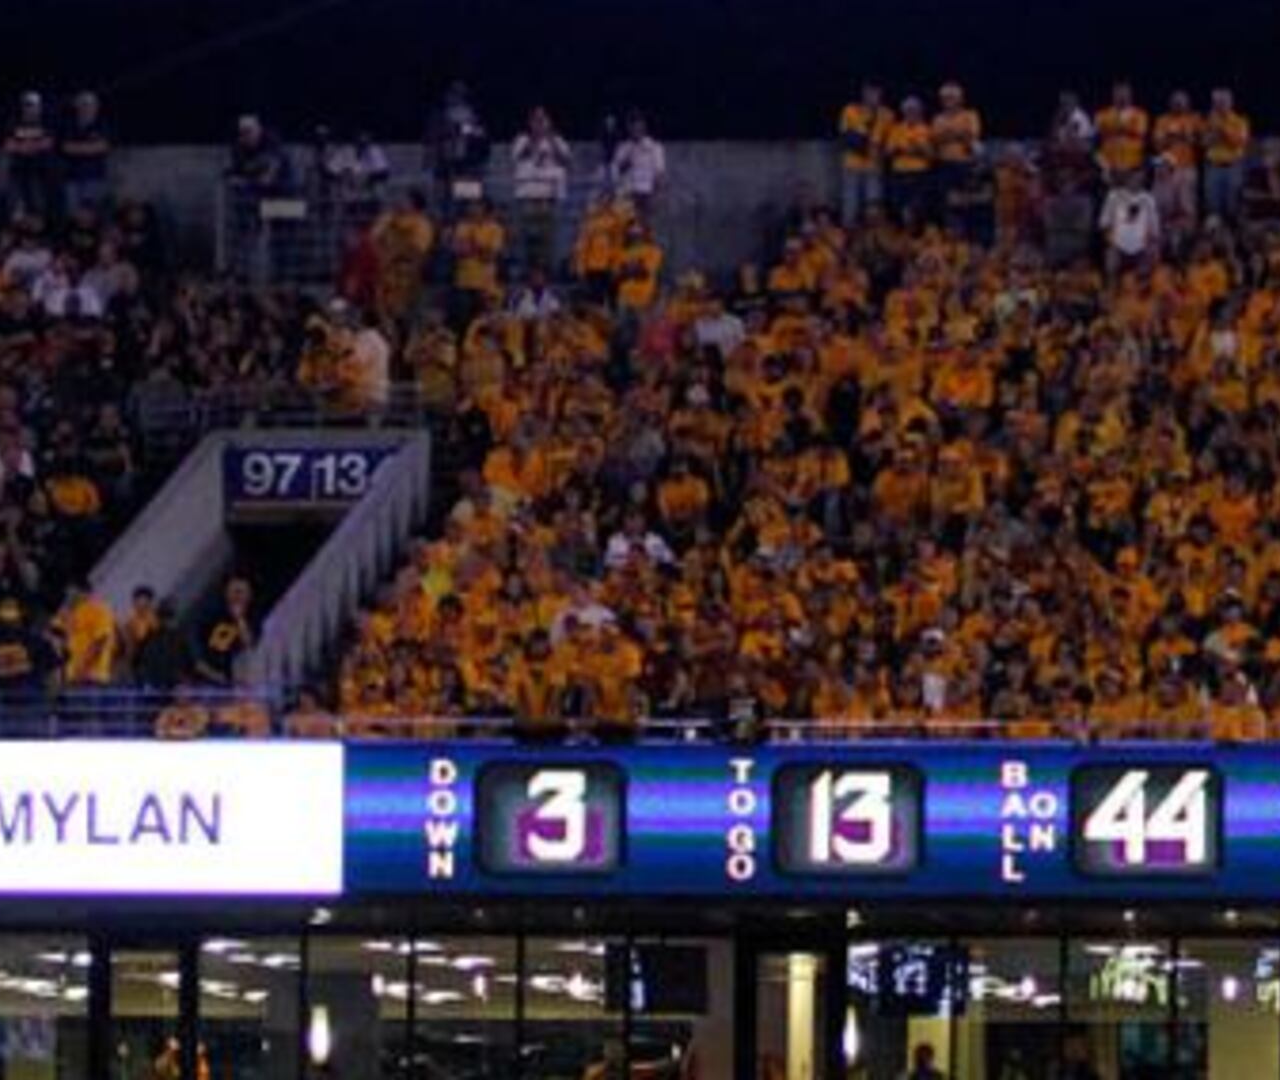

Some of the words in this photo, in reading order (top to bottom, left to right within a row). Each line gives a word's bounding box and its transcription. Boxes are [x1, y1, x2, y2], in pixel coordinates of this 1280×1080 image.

[241, 452, 302, 496] 97
[424, 758, 459, 879] DOWN
[526, 770, 588, 862] 3
[808, 769, 892, 864] 13
[1001, 761, 1028, 882] BALL
[1030, 793, 1058, 851] ON
[1082, 769, 1210, 865] 44
